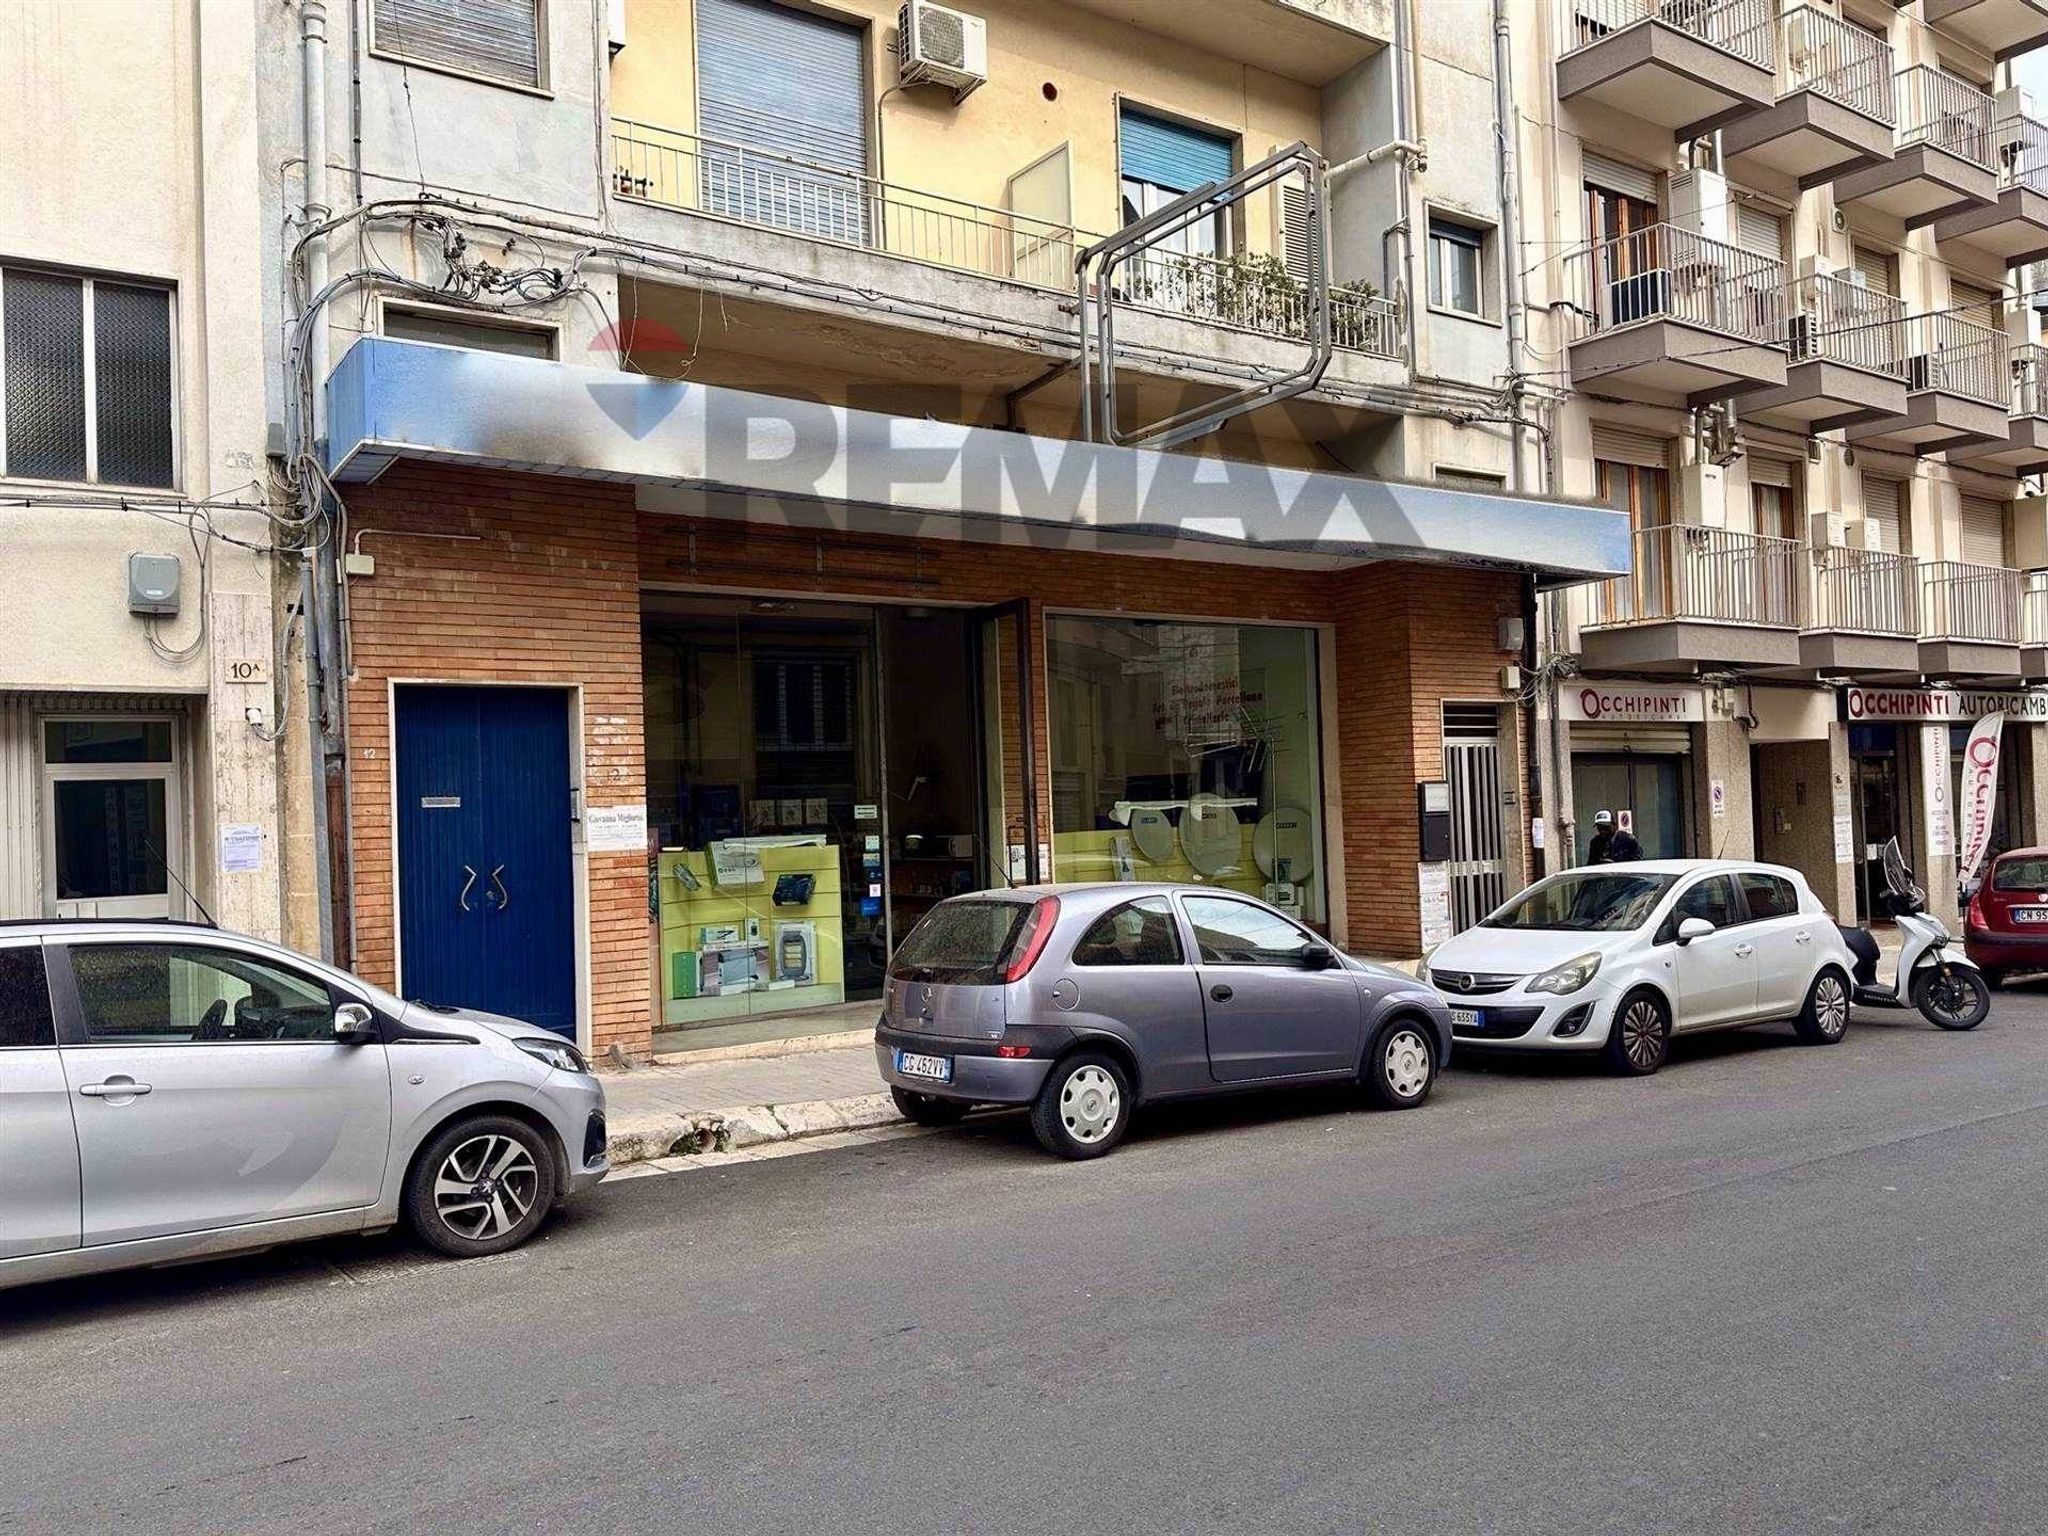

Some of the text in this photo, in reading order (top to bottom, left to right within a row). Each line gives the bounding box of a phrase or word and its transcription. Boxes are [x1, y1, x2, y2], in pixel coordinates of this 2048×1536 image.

[1580, 688, 1687, 719] OCCHIPINTI
[1849, 689, 1949, 718] OCCHIPINTI
[363, 748, 376, 759] 12
